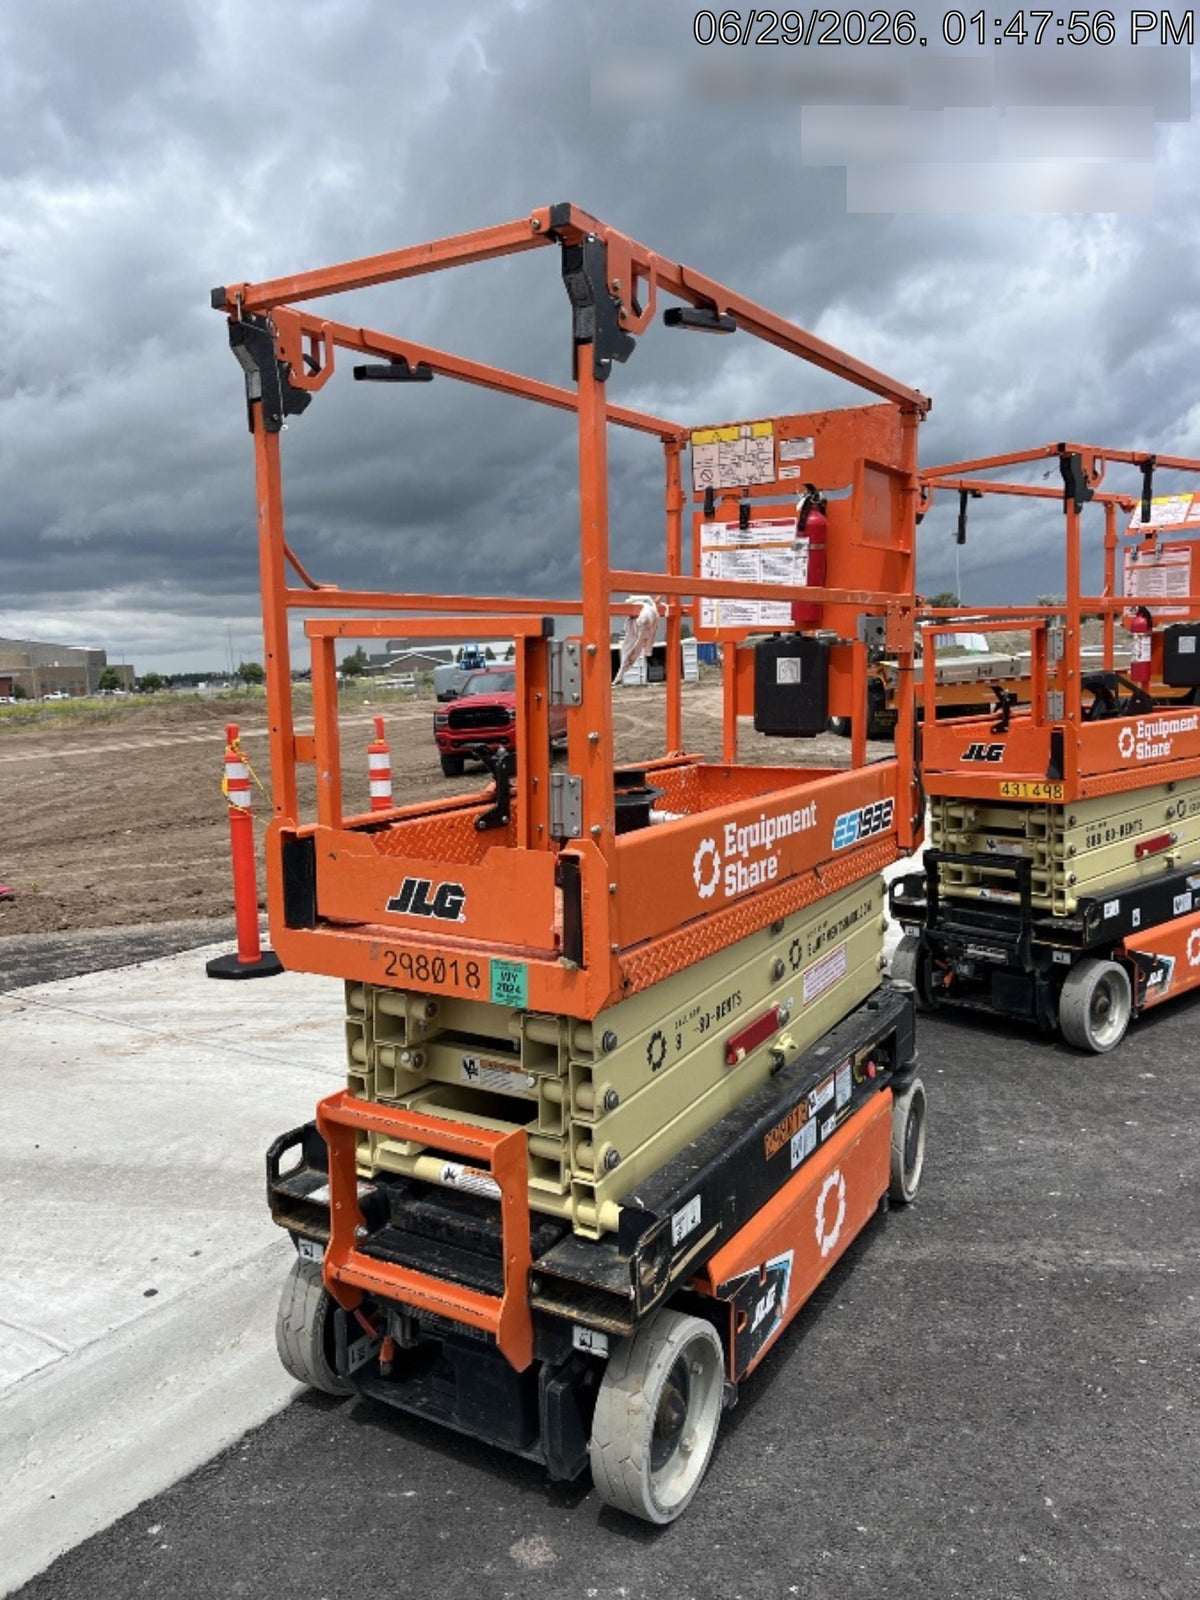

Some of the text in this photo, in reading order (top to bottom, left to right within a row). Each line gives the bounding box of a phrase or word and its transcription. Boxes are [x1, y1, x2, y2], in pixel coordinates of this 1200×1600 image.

[1136, 714, 1199, 741] Equipment
[960, 742, 1006, 763] JLG
[1136, 741, 1171, 760] Share
[723, 800, 818, 858] Equipment
[724, 854, 778, 897] Share
[385, 876, 466, 923] JLG
[383, 950, 481, 990] 298018
